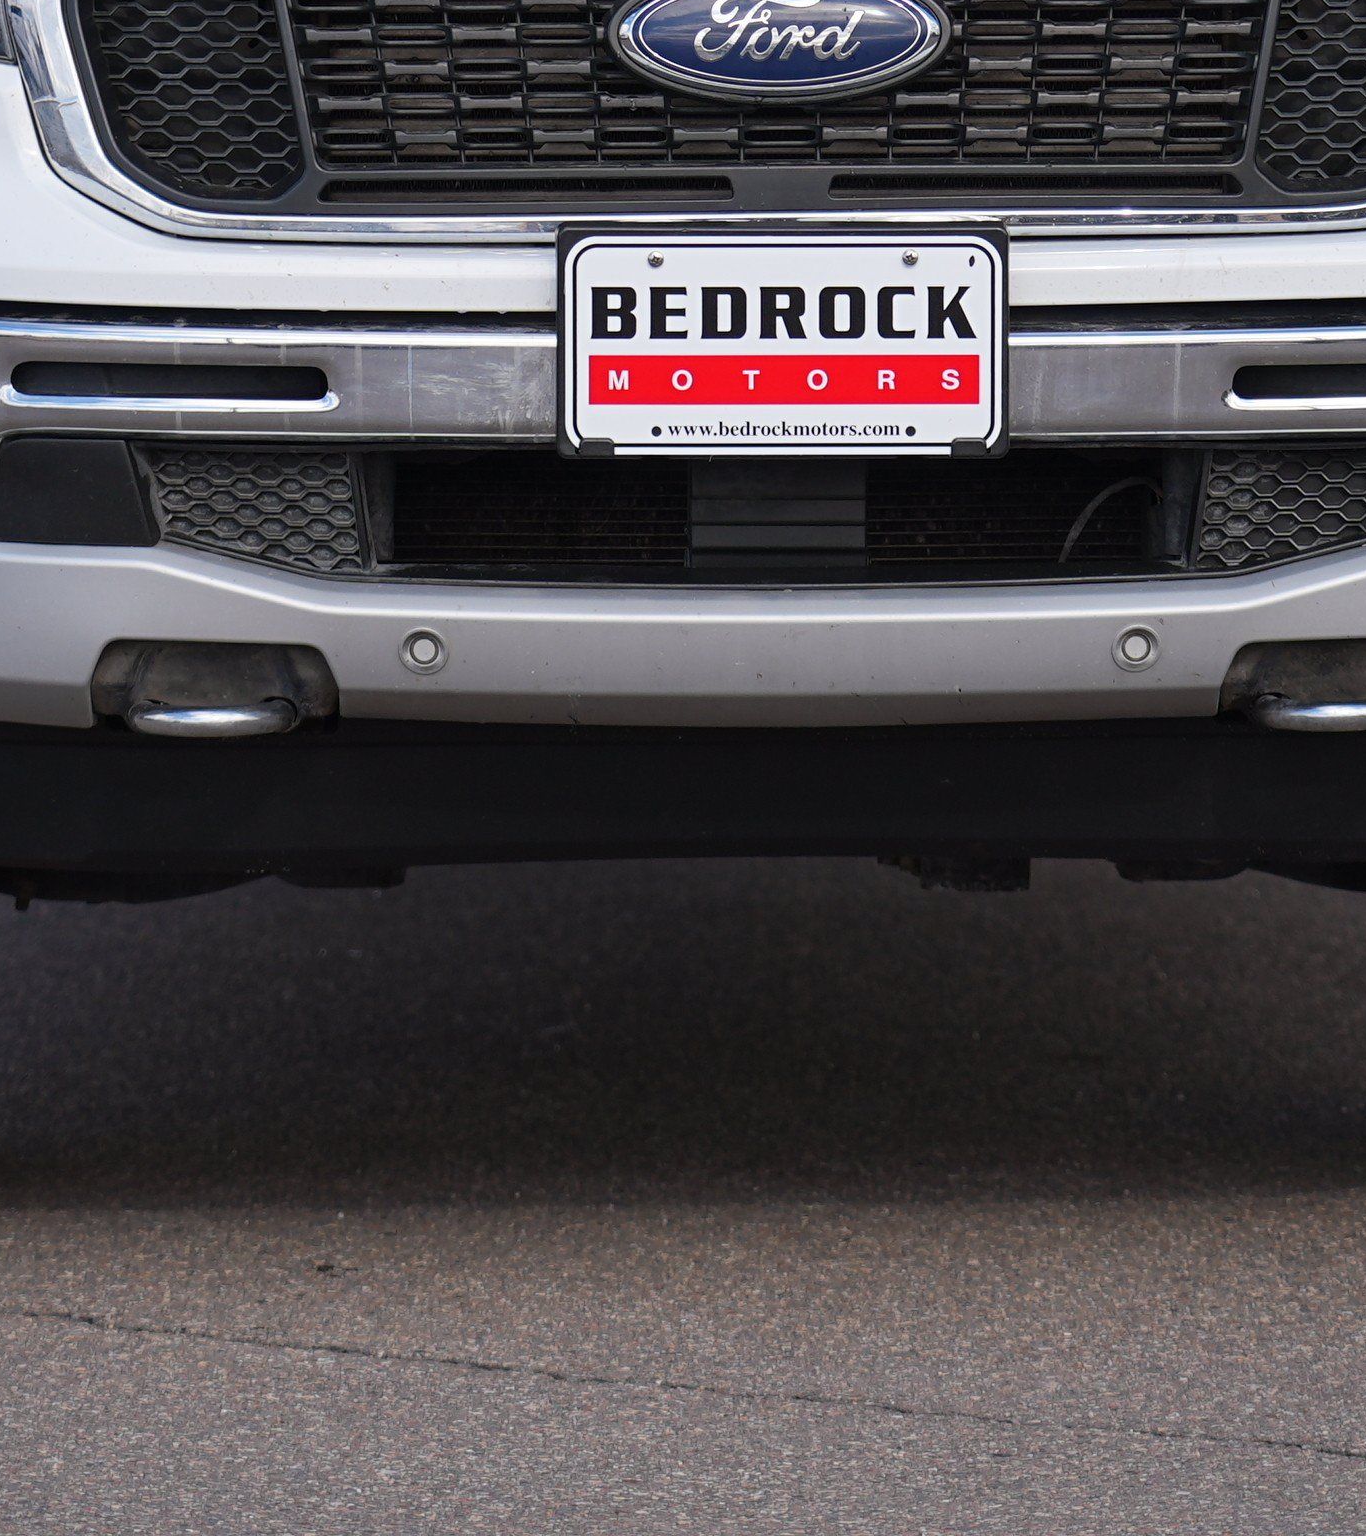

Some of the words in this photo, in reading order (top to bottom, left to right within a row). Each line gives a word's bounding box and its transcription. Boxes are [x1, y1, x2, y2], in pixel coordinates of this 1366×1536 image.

[590, 286, 977, 340] BEDROCK
[608, 368, 960, 391] MOTORS
[668, 421, 901, 438] www.bedrockmotors.com
